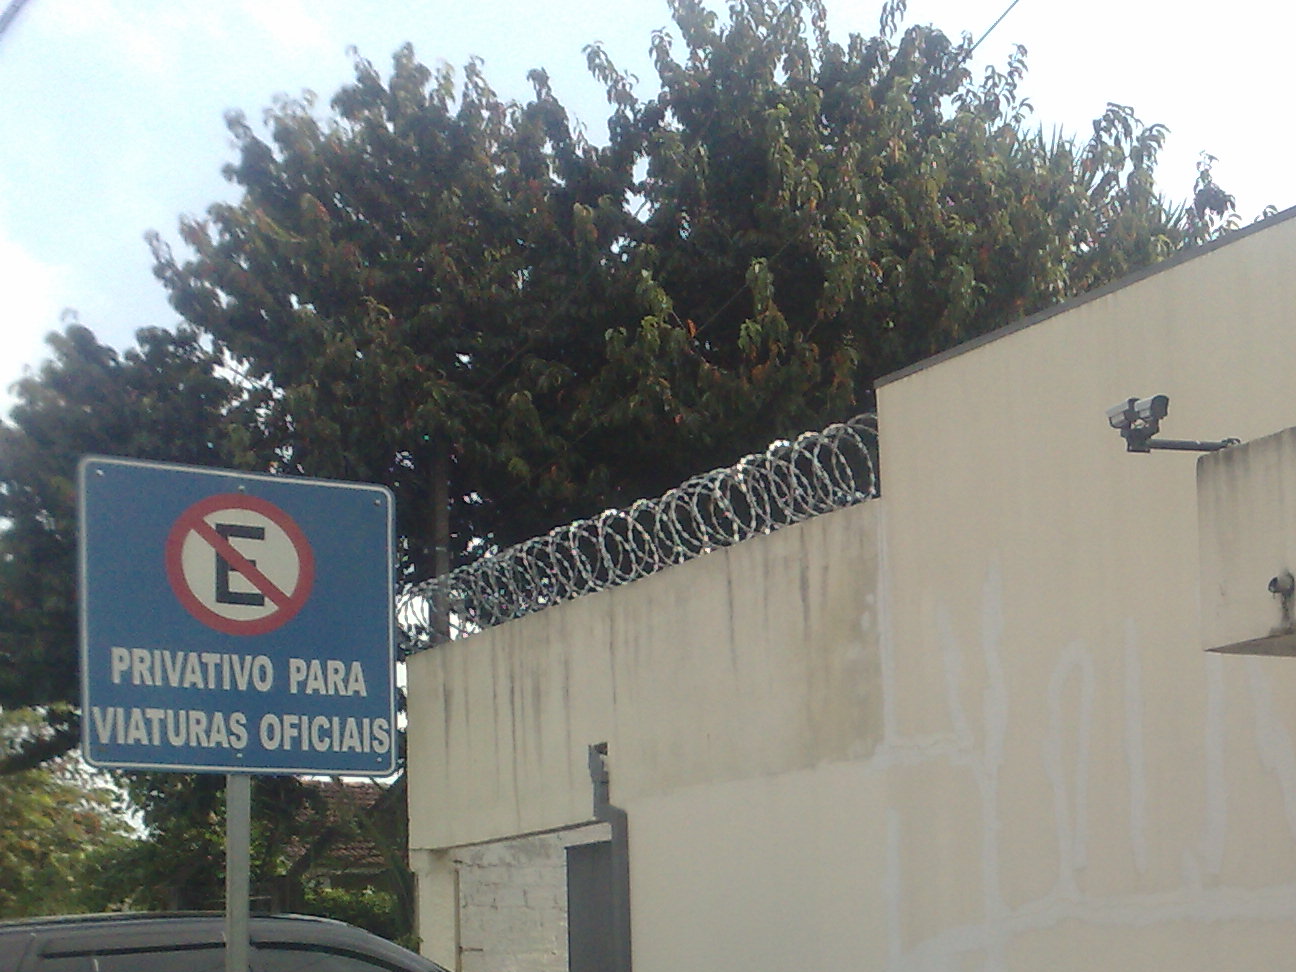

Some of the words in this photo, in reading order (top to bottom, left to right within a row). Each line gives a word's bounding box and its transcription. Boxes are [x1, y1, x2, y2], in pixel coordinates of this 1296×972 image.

[111, 647, 274, 692] PRIVATIVO
[289, 658, 367, 697] PARA
[92, 706, 249, 749] VIATURAS
[259, 713, 390, 754] OFICIAIS
